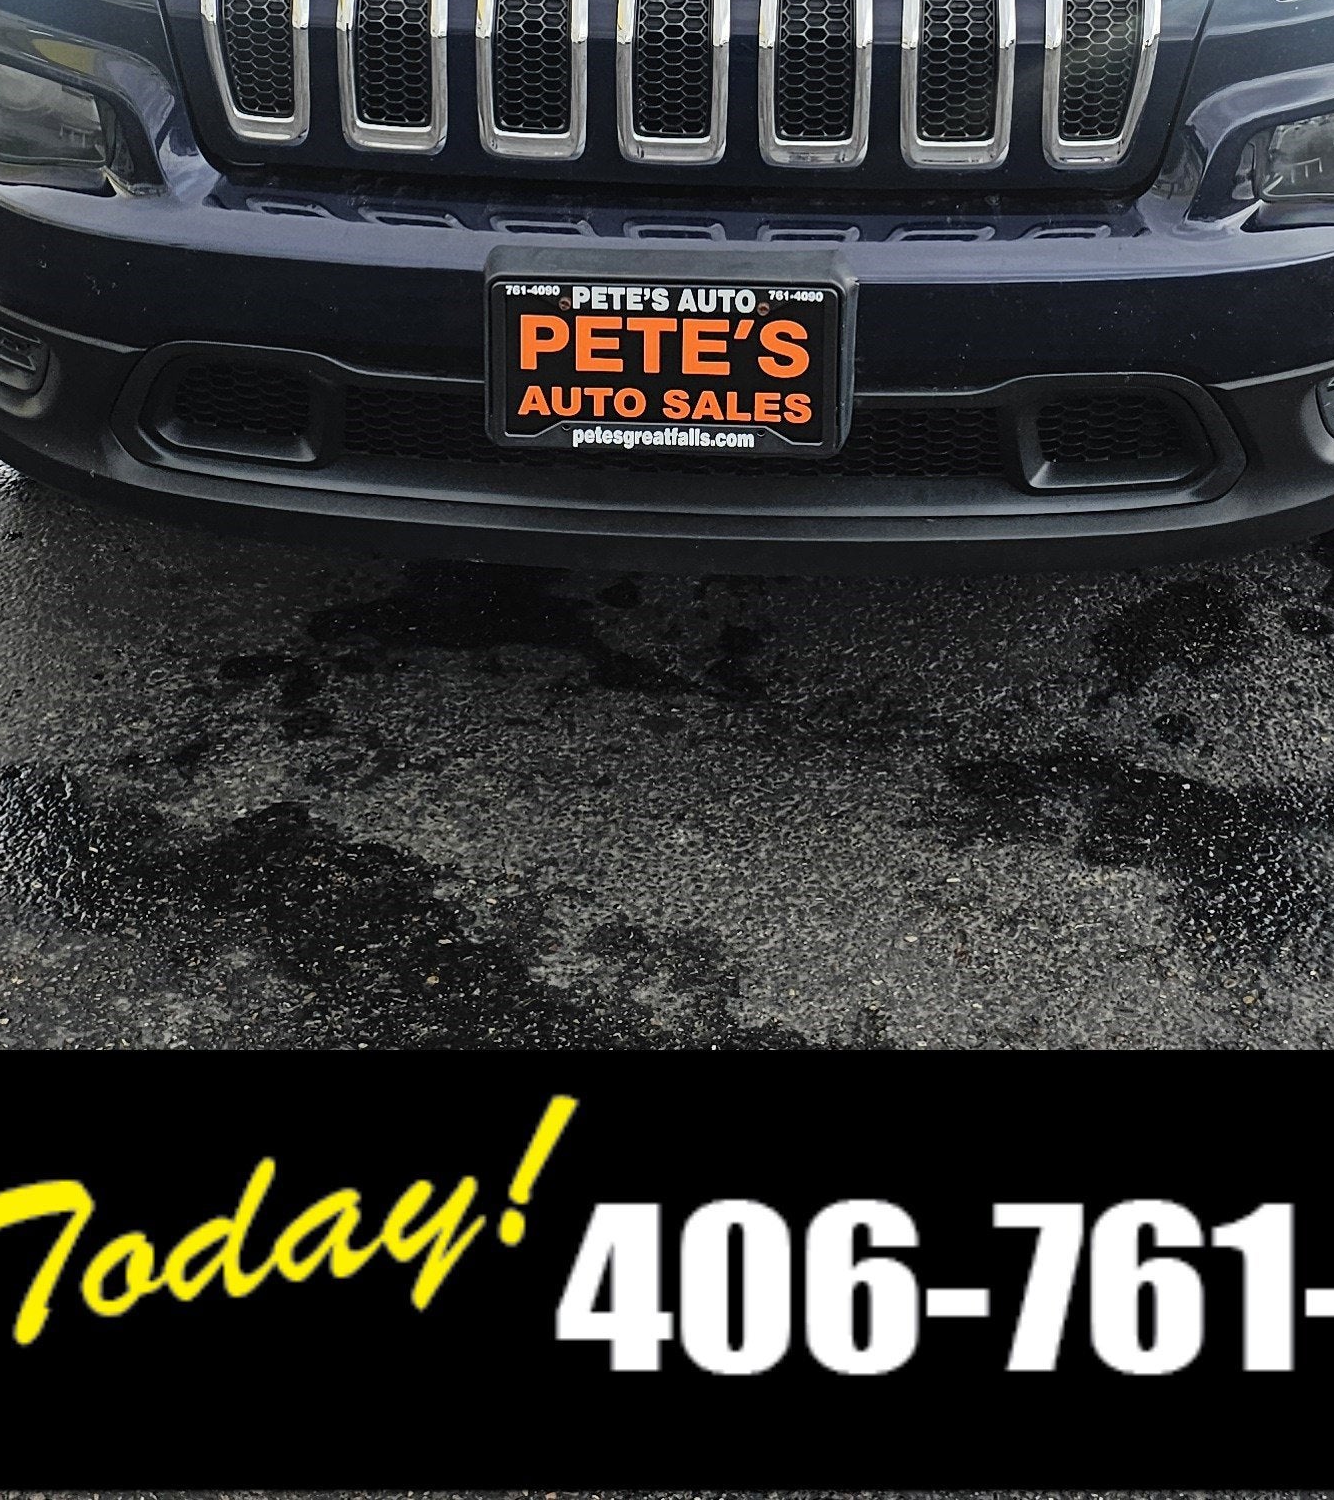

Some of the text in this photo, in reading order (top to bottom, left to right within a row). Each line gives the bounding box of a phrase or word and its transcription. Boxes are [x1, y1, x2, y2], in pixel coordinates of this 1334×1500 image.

[505, 285, 560, 296] 761-4090
[572, 286, 756, 314] PETE'S AUTO
[768, 290, 824, 303] 761-4090
[520, 314, 810, 378] PETE'S
[518, 385, 812, 424] AUTO SALES
[572, 426, 755, 449] petesgreatfalls.com
